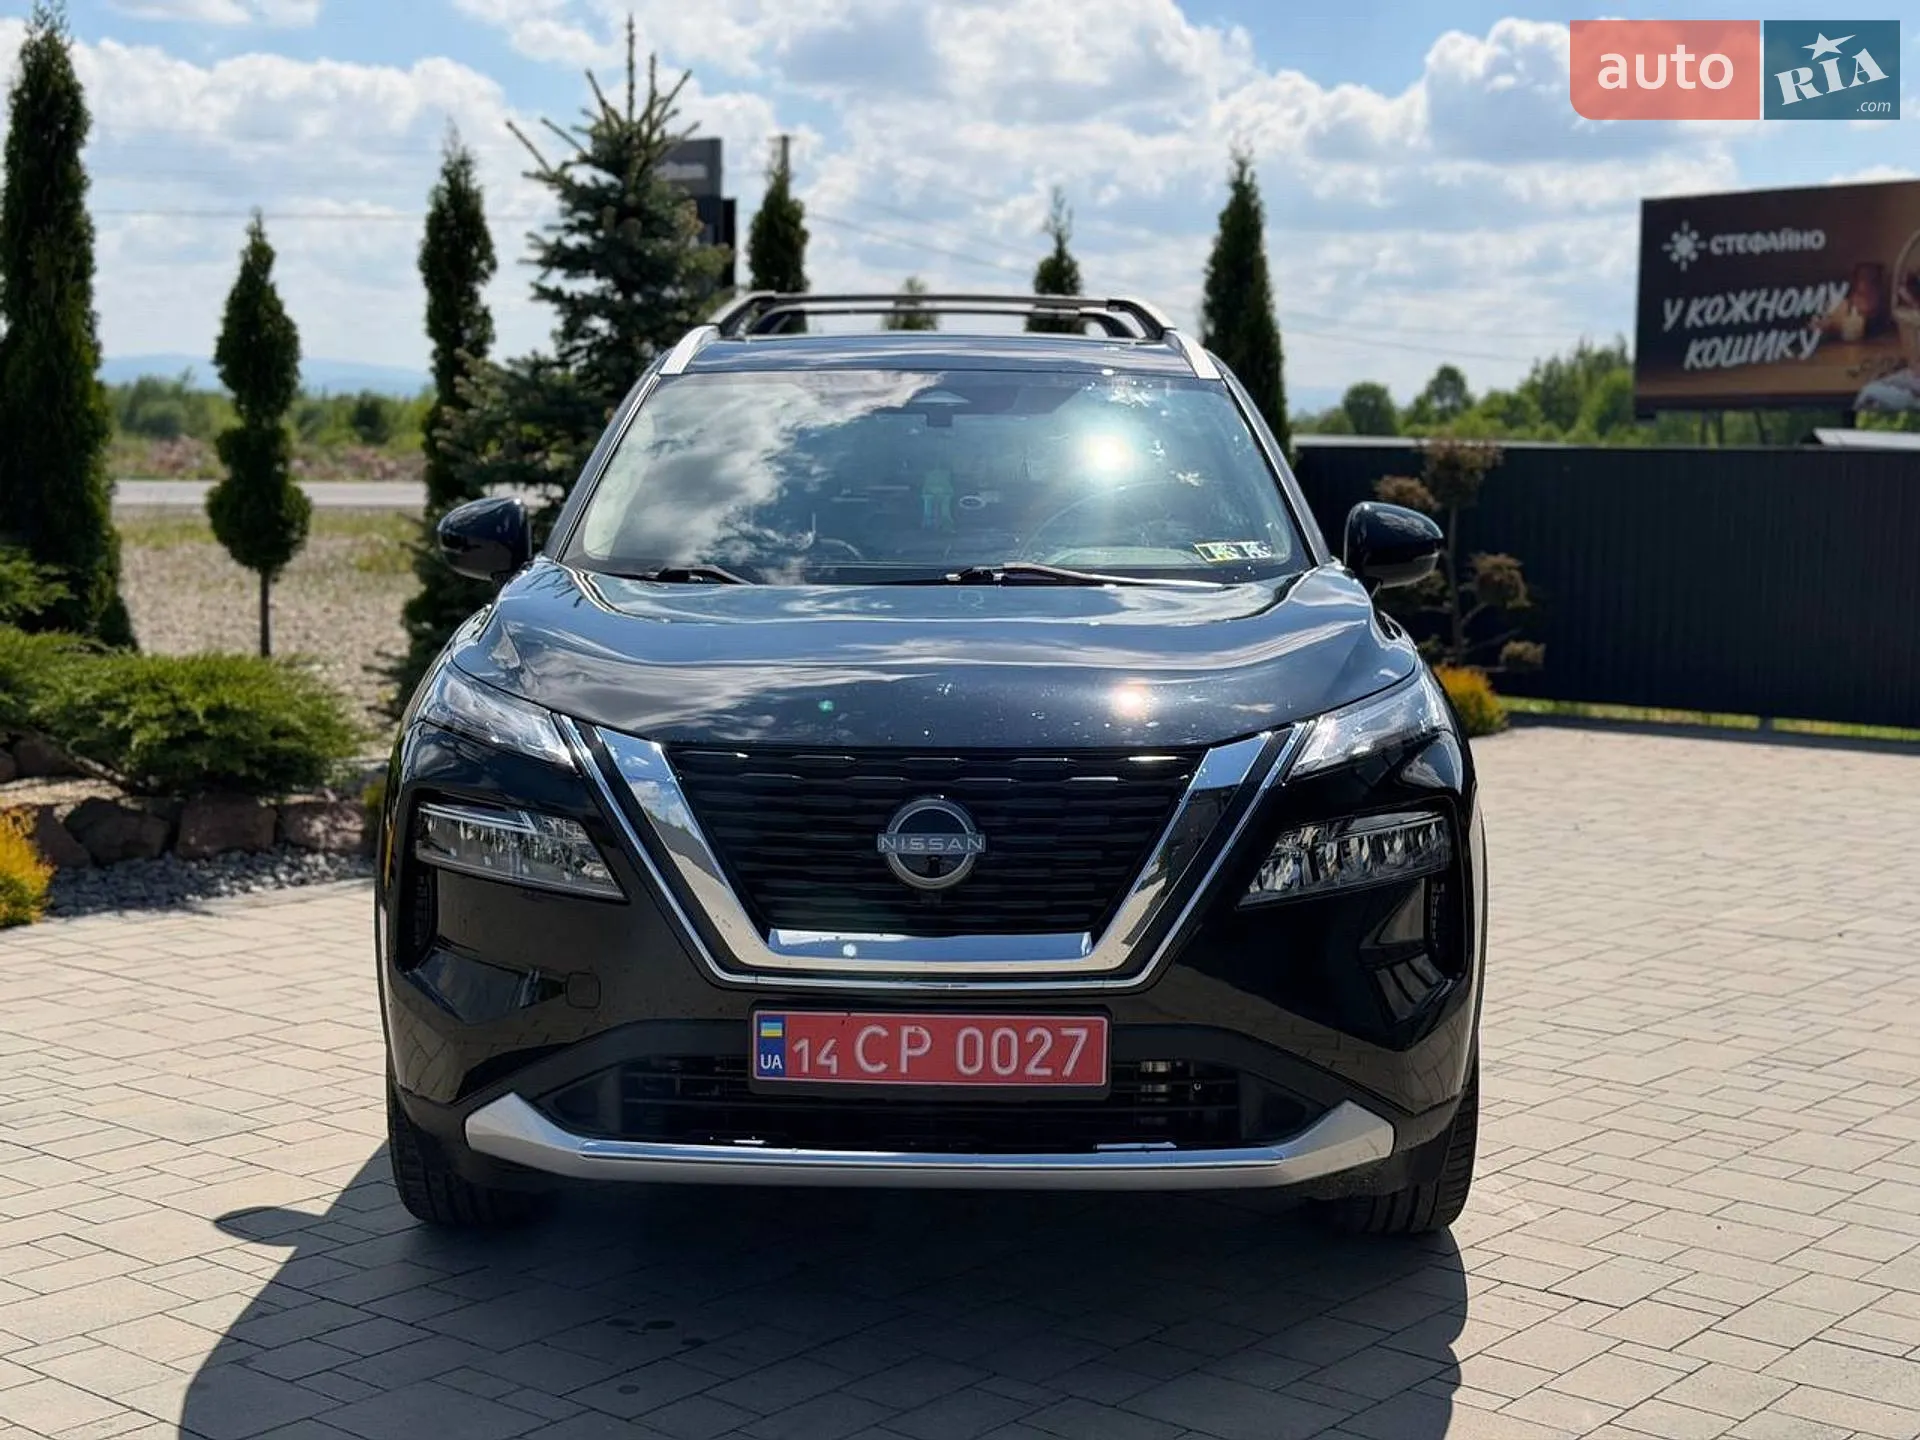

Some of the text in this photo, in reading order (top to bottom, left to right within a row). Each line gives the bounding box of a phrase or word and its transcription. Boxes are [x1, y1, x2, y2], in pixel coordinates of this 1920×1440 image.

[1709, 228, 1826, 255] СТЕФАЙНО
[1663, 281, 1849, 332] У КОЖНОМУ
[1683, 328, 1822, 371] КОШИКУ
[880, 837, 983, 851] NISSAN
[760, 1054, 782, 1070] UA
[792, 1024, 1089, 1077] 14 CP 0027
